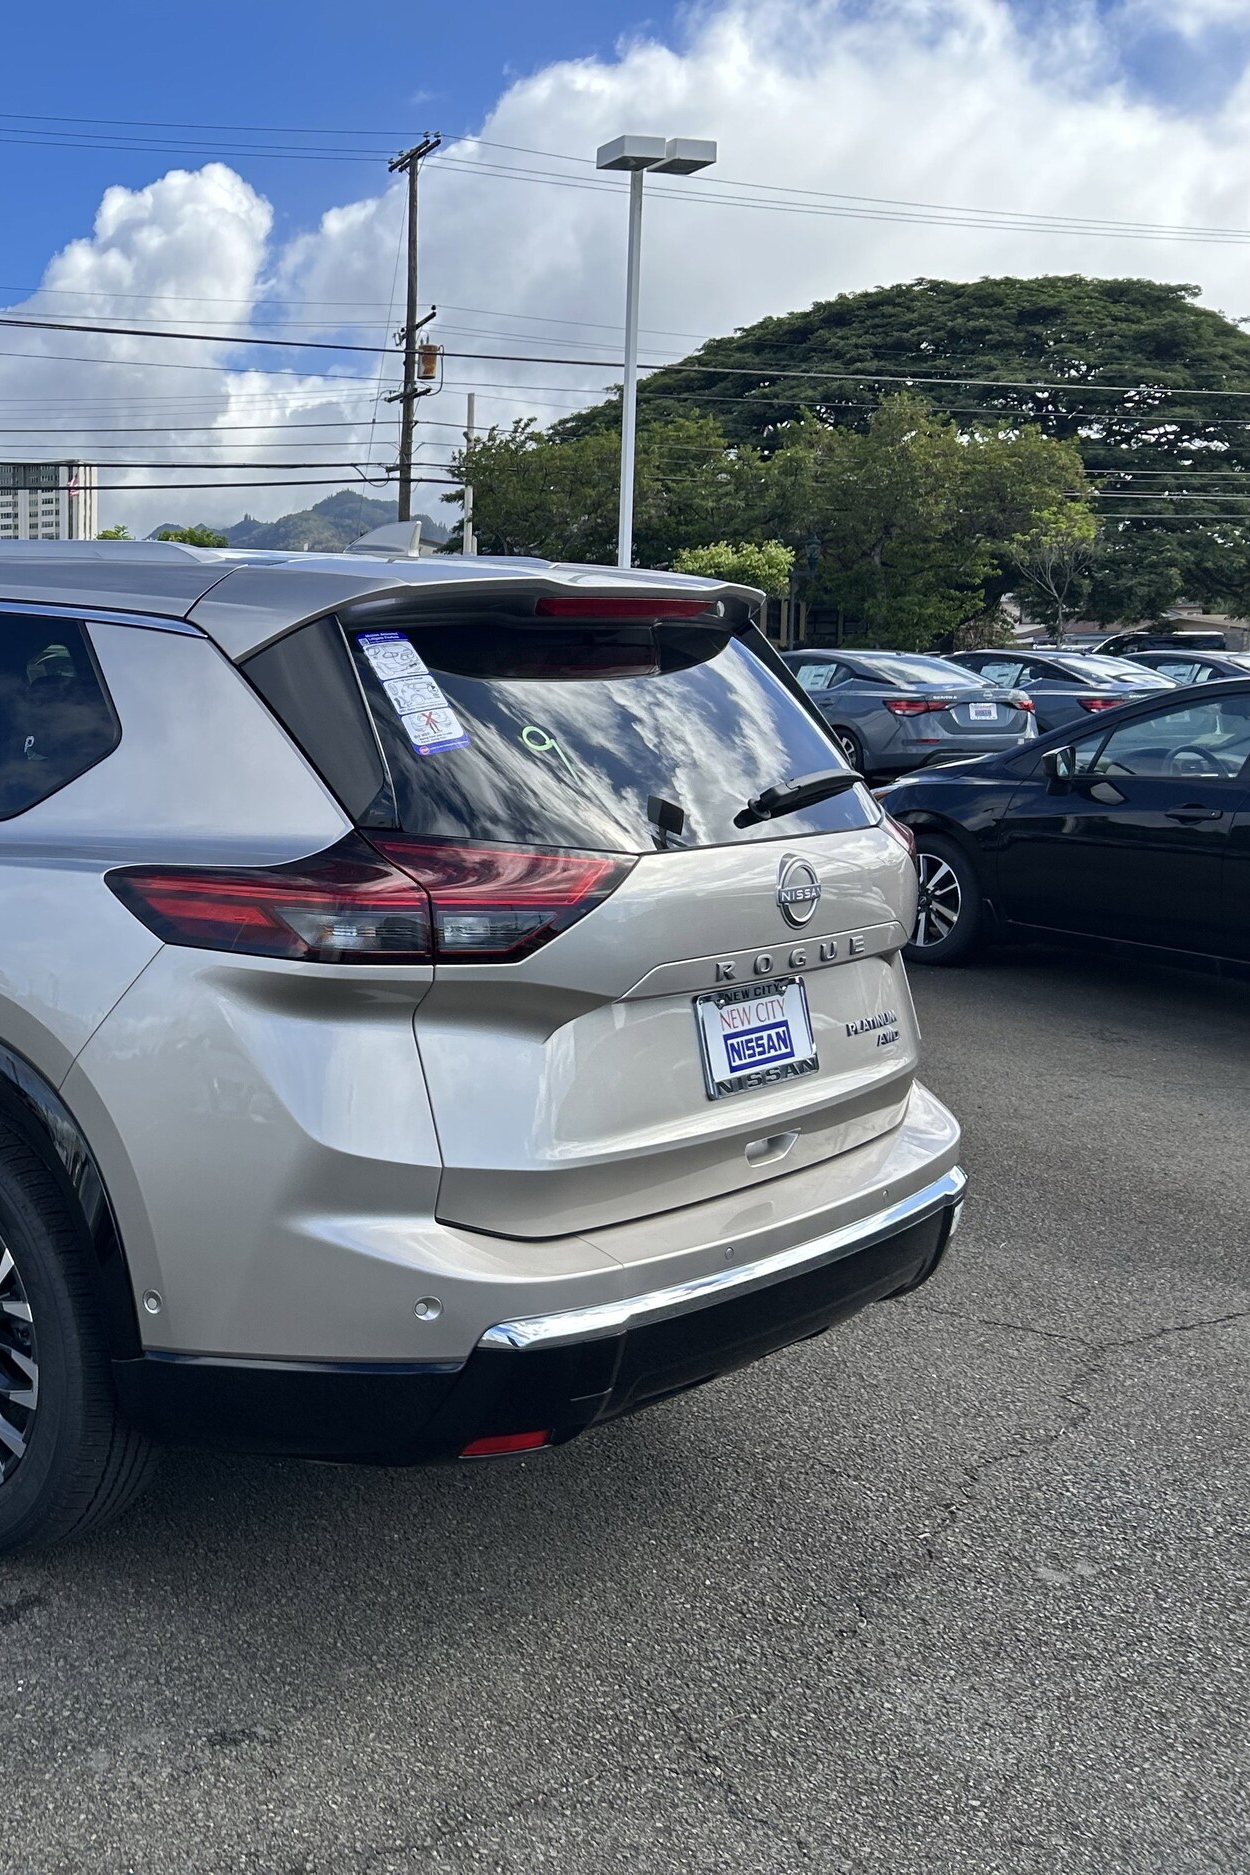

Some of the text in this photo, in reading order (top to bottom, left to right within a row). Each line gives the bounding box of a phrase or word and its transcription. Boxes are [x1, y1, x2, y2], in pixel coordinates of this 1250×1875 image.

[715, 935, 865, 982] ROGUE
[724, 983, 781, 1002] NEW CITY
[719, 998, 785, 1032] NEW CITY
[845, 1009, 898, 1037] PLATINUM
[729, 1030, 789, 1063] NISSAN
[876, 1030, 901, 1047] AWD
[716, 1058, 818, 1096] NISSAN
